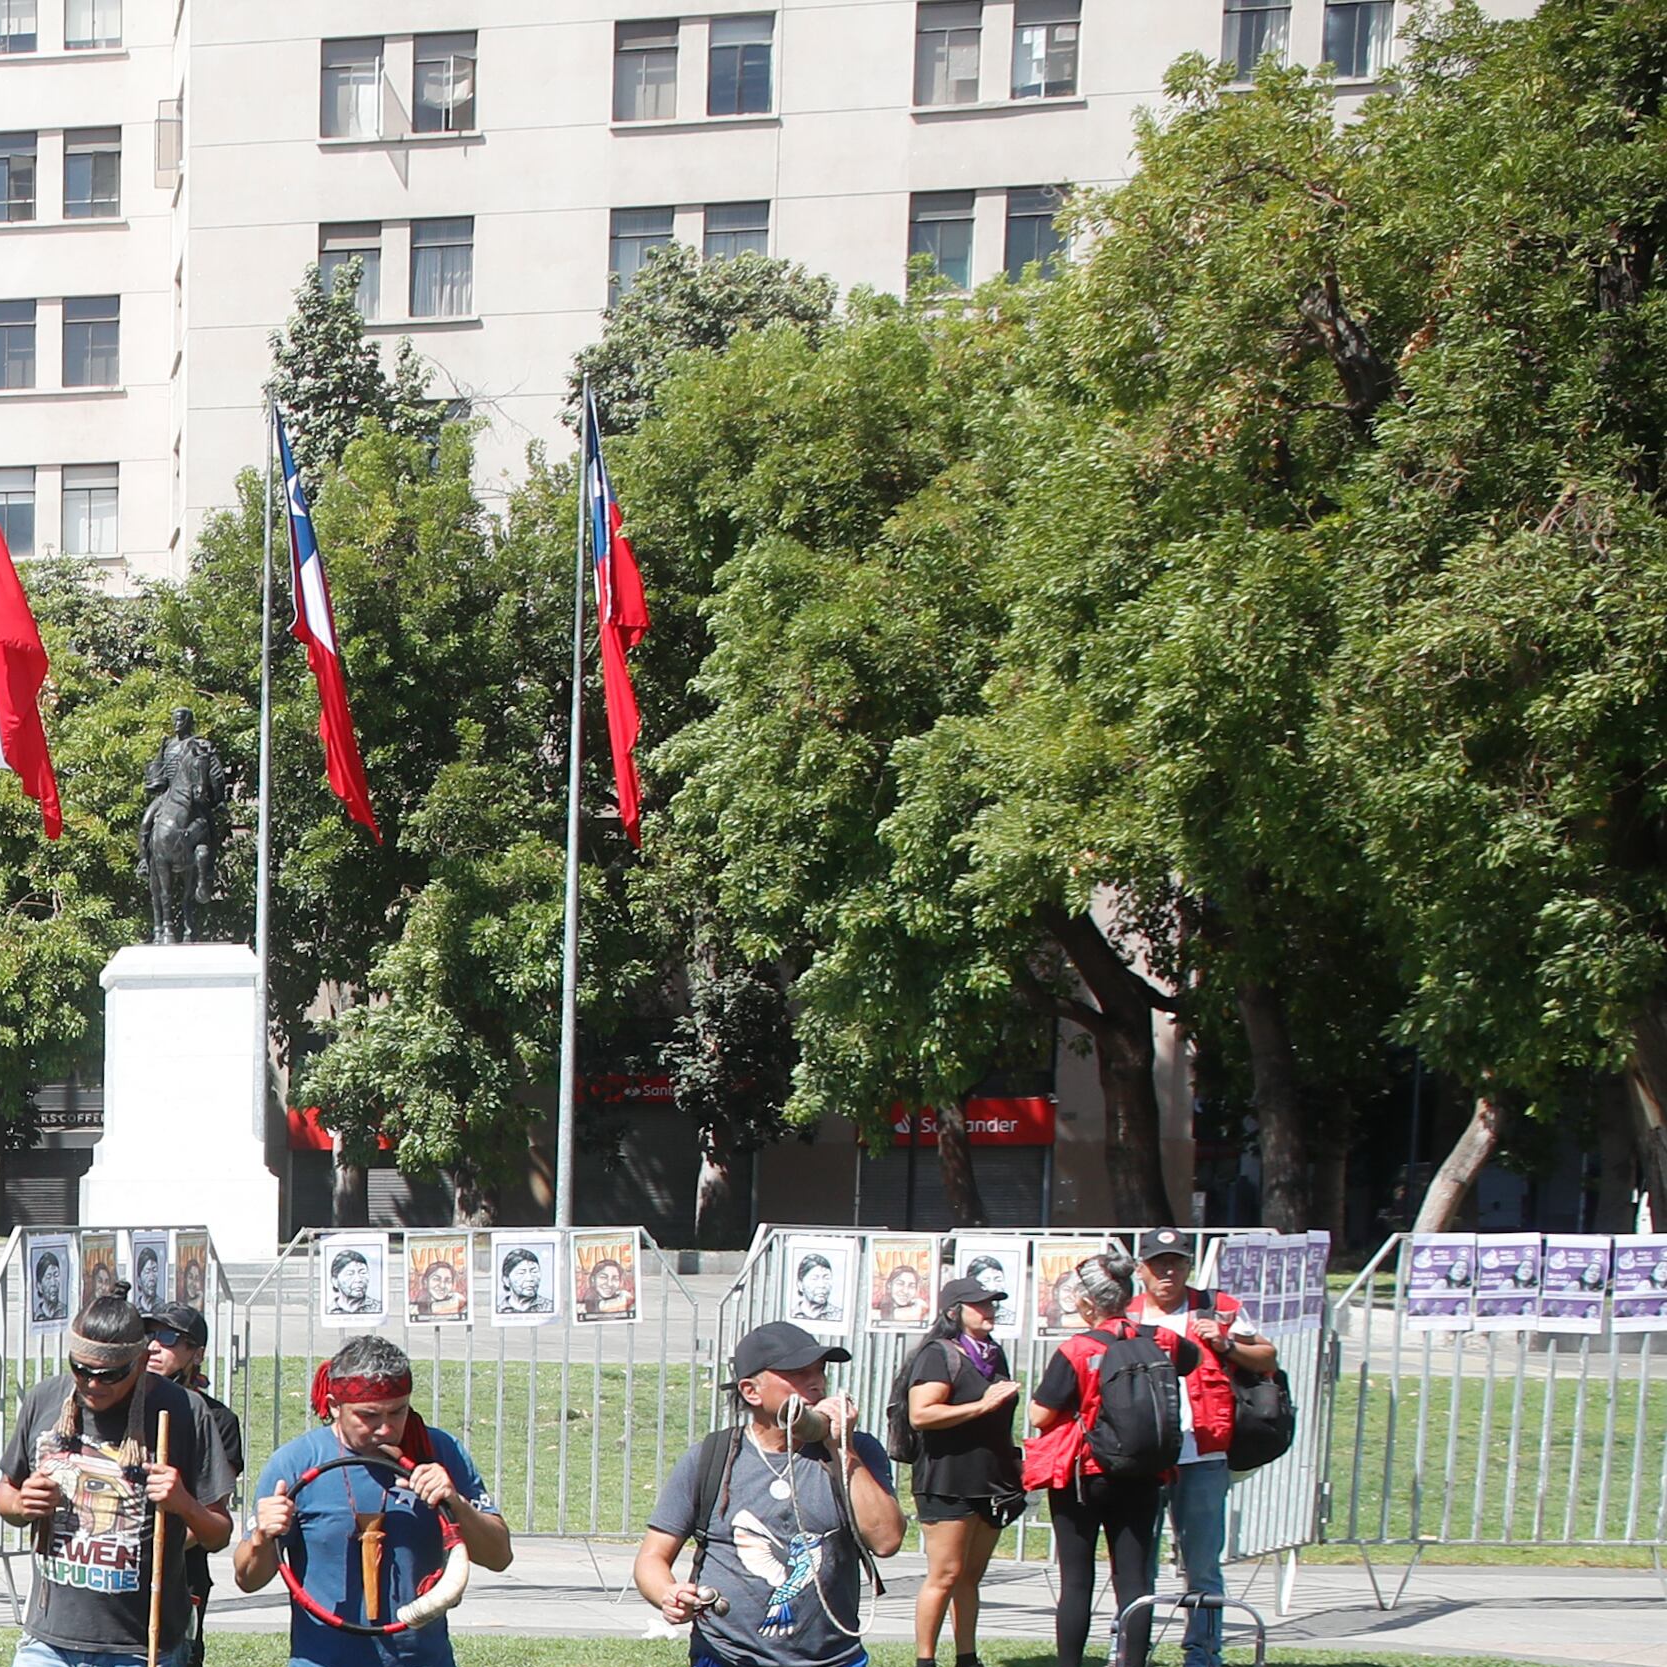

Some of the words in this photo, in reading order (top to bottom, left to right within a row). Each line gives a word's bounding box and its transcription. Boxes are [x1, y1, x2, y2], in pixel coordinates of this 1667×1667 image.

[921, 1117, 1017, 1133] Saander
[411, 1246, 465, 1272] VIVE
[577, 1244, 632, 1271] VIVE
[876, 1250, 929, 1275] VIVE
[1040, 1255, 1086, 1279] VIV
[47, 1533, 139, 1570] EWEN
[41, 1559, 140, 1592] APUCHE
